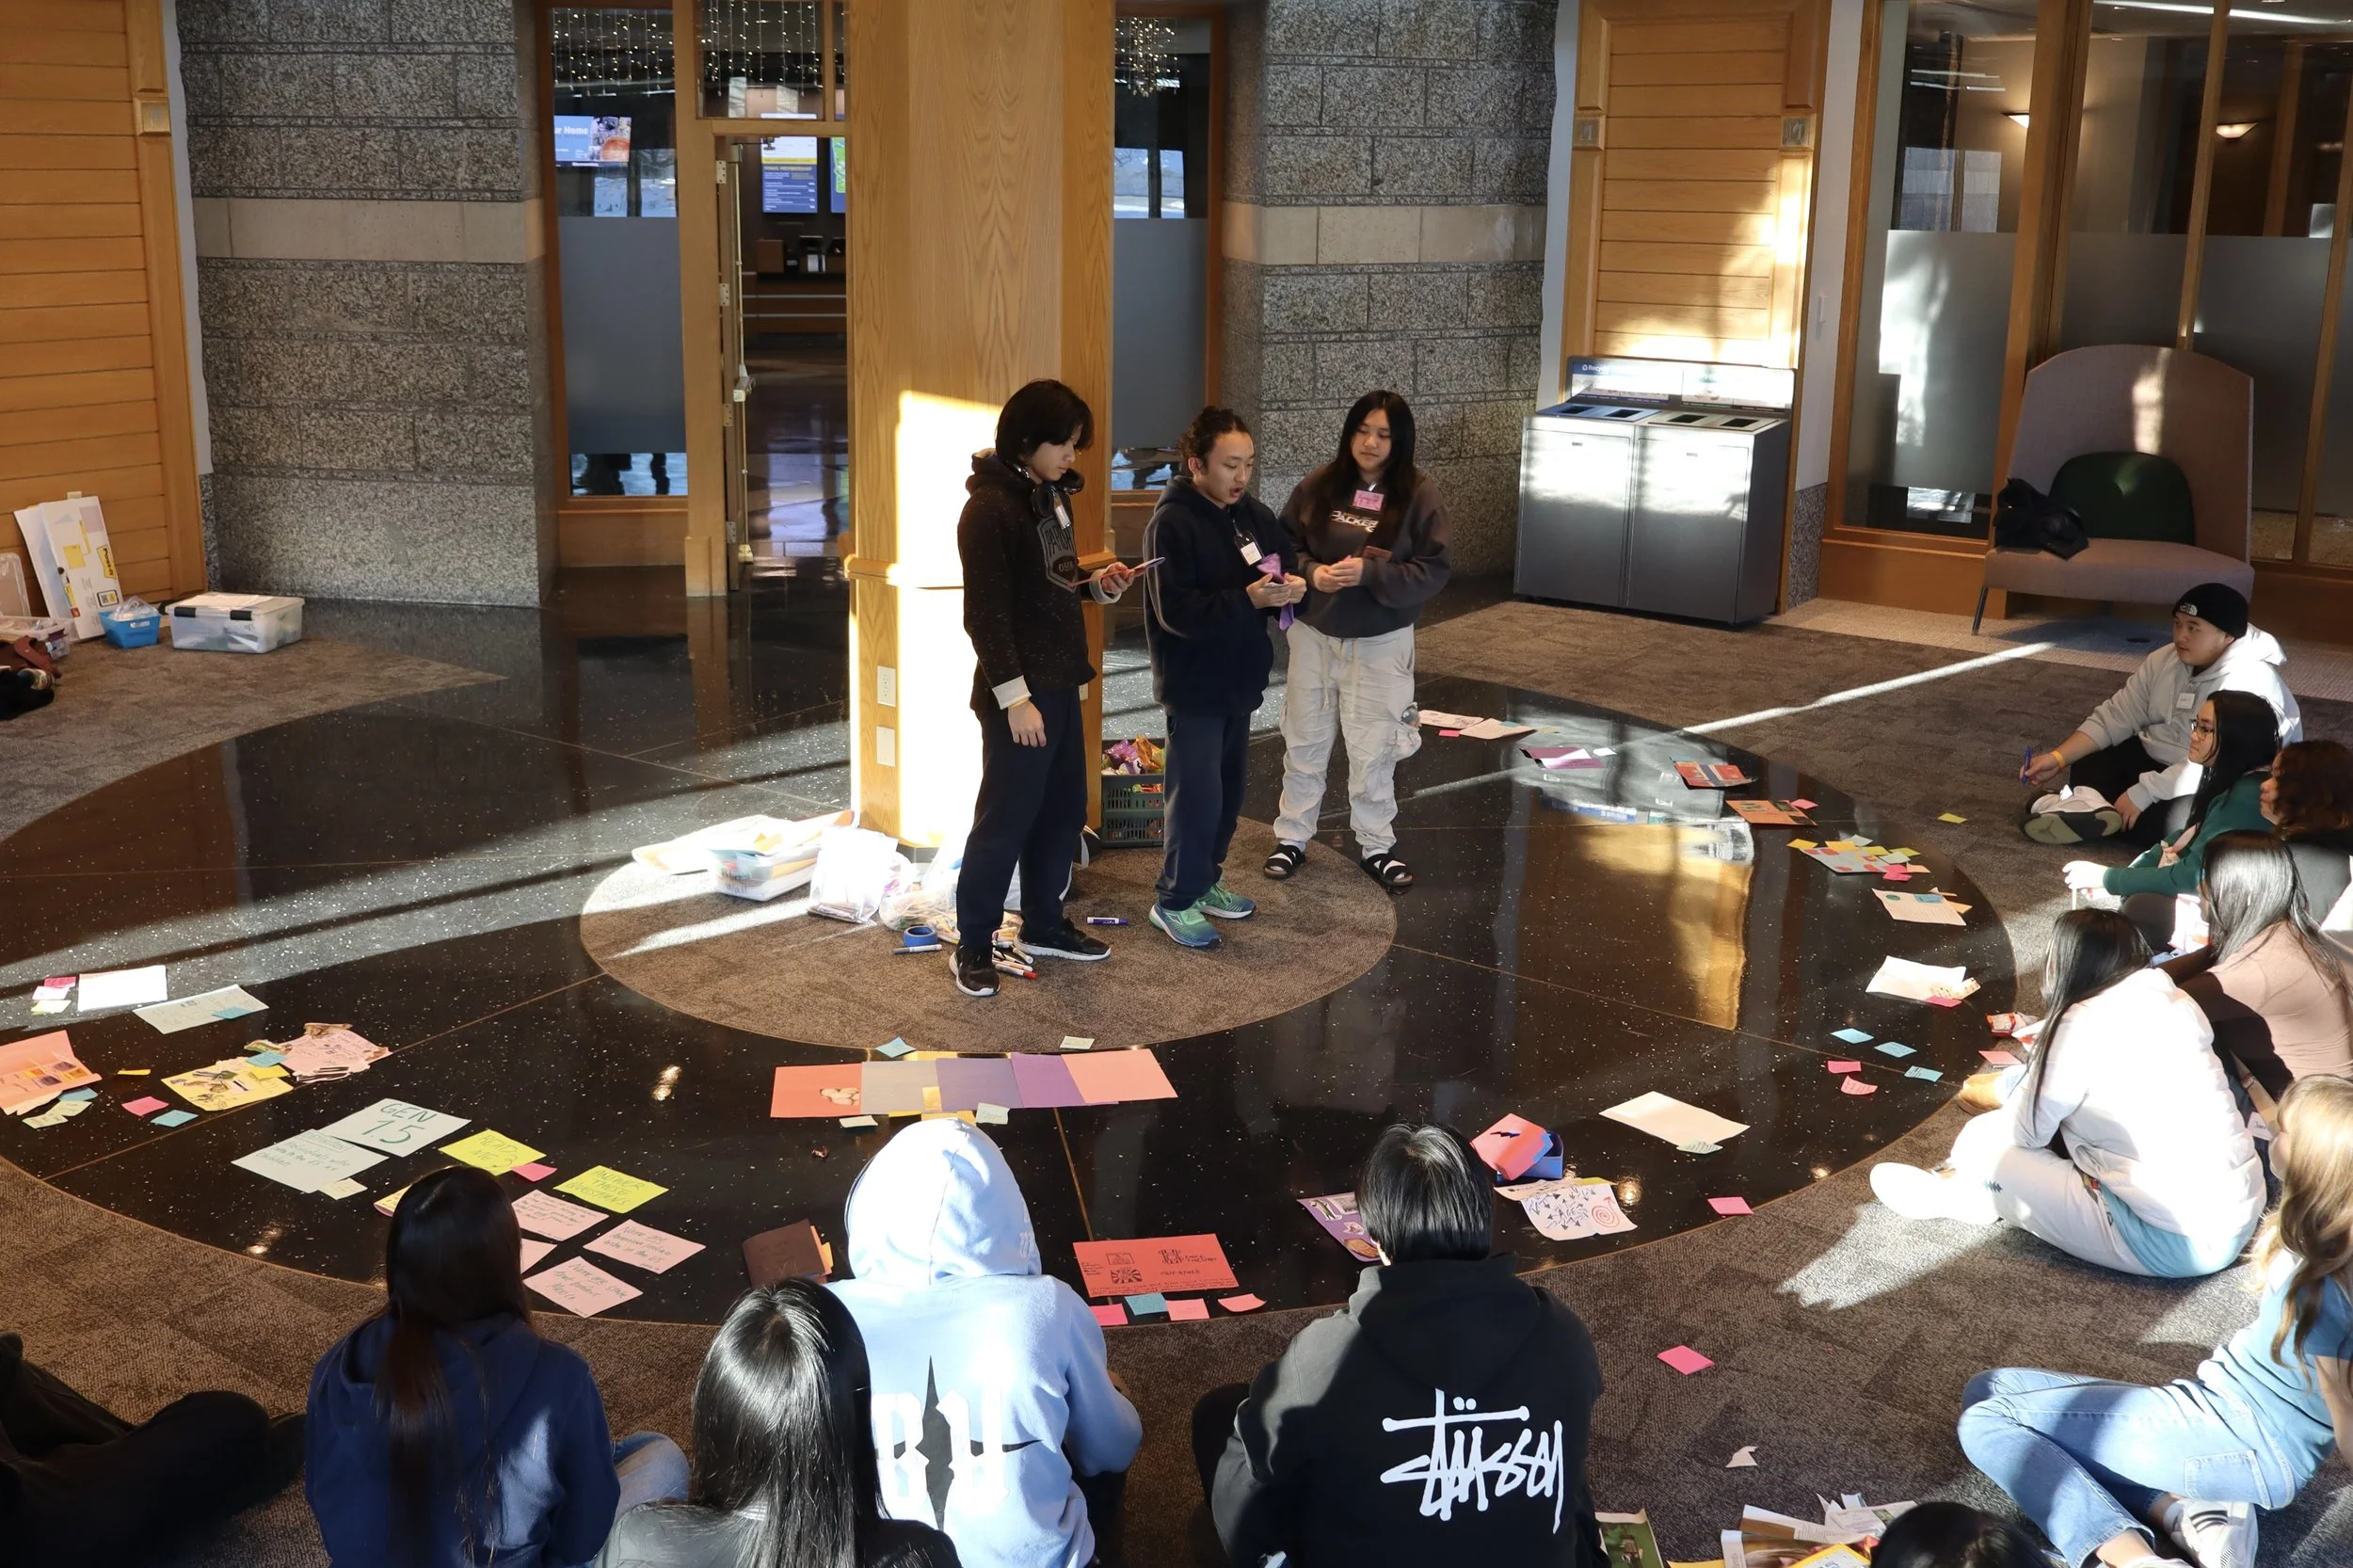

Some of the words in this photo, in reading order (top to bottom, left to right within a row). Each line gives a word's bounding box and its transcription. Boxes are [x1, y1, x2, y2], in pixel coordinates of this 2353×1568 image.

[564, 125, 588, 135] Home
[1332, 510, 1379, 527] PACKER
[380, 1103, 438, 1123] GEN
